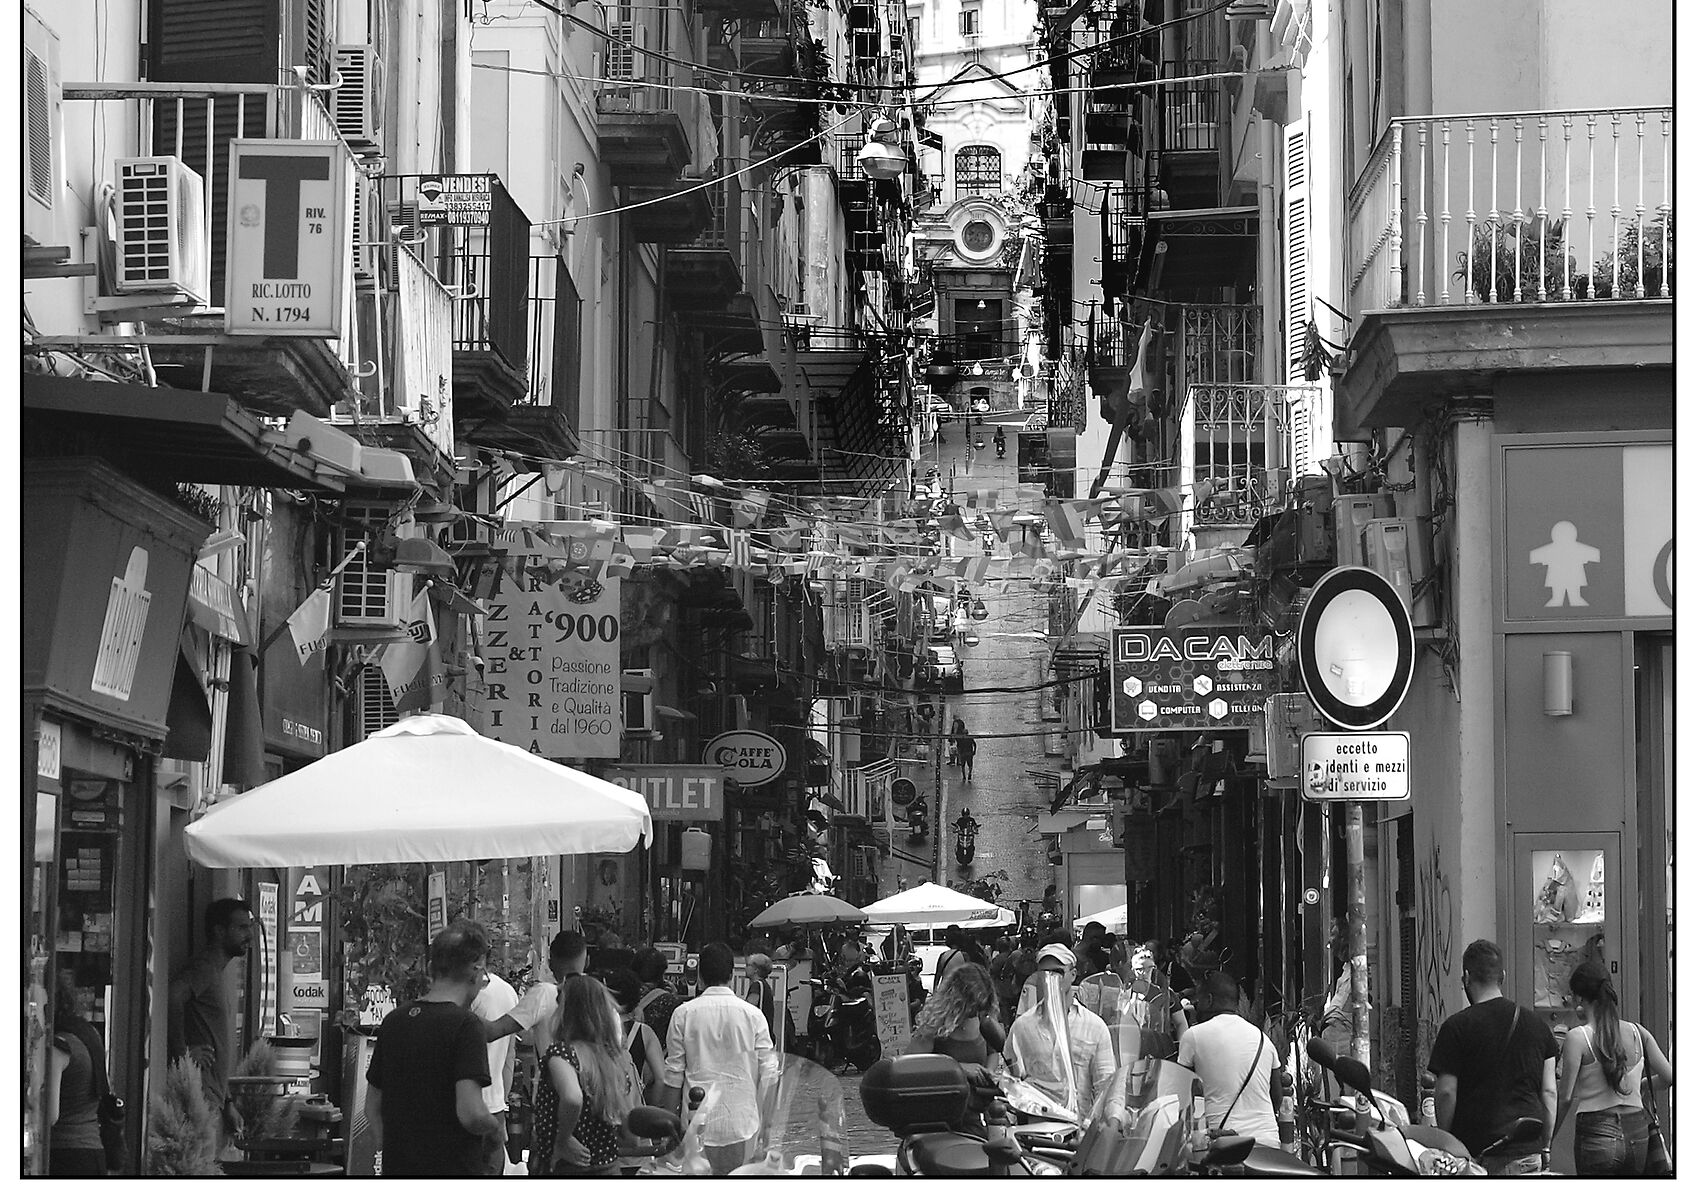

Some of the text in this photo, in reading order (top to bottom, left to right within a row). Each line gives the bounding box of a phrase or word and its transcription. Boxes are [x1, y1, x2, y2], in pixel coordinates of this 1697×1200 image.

[442, 176, 490, 193] VENDESI
[238, 154, 330, 280] T
[305, 208, 326, 219] RIV.
[308, 224, 322, 234] 76
[252, 284, 311, 299] RIC. LOTTO
[252, 307, 311, 322] N. 1794
[1118, 633, 1273, 662] DACAM
[551, 656, 611, 674] Passione
[1217, 657, 1274, 671] elettronica
[549, 677, 614, 695] Tradizione
[1148, 683, 1262, 693] VENDITA ASSISTENZA
[551, 697, 611, 716] e Qualità
[1160, 706, 1201, 715] COMPUTER
[550, 719, 612, 736] dal 1960
[1336, 741, 1378, 755] eccetto
[1317, 759, 1405, 773] identi e mezzi
[1328, 778, 1387, 792] di servizio
